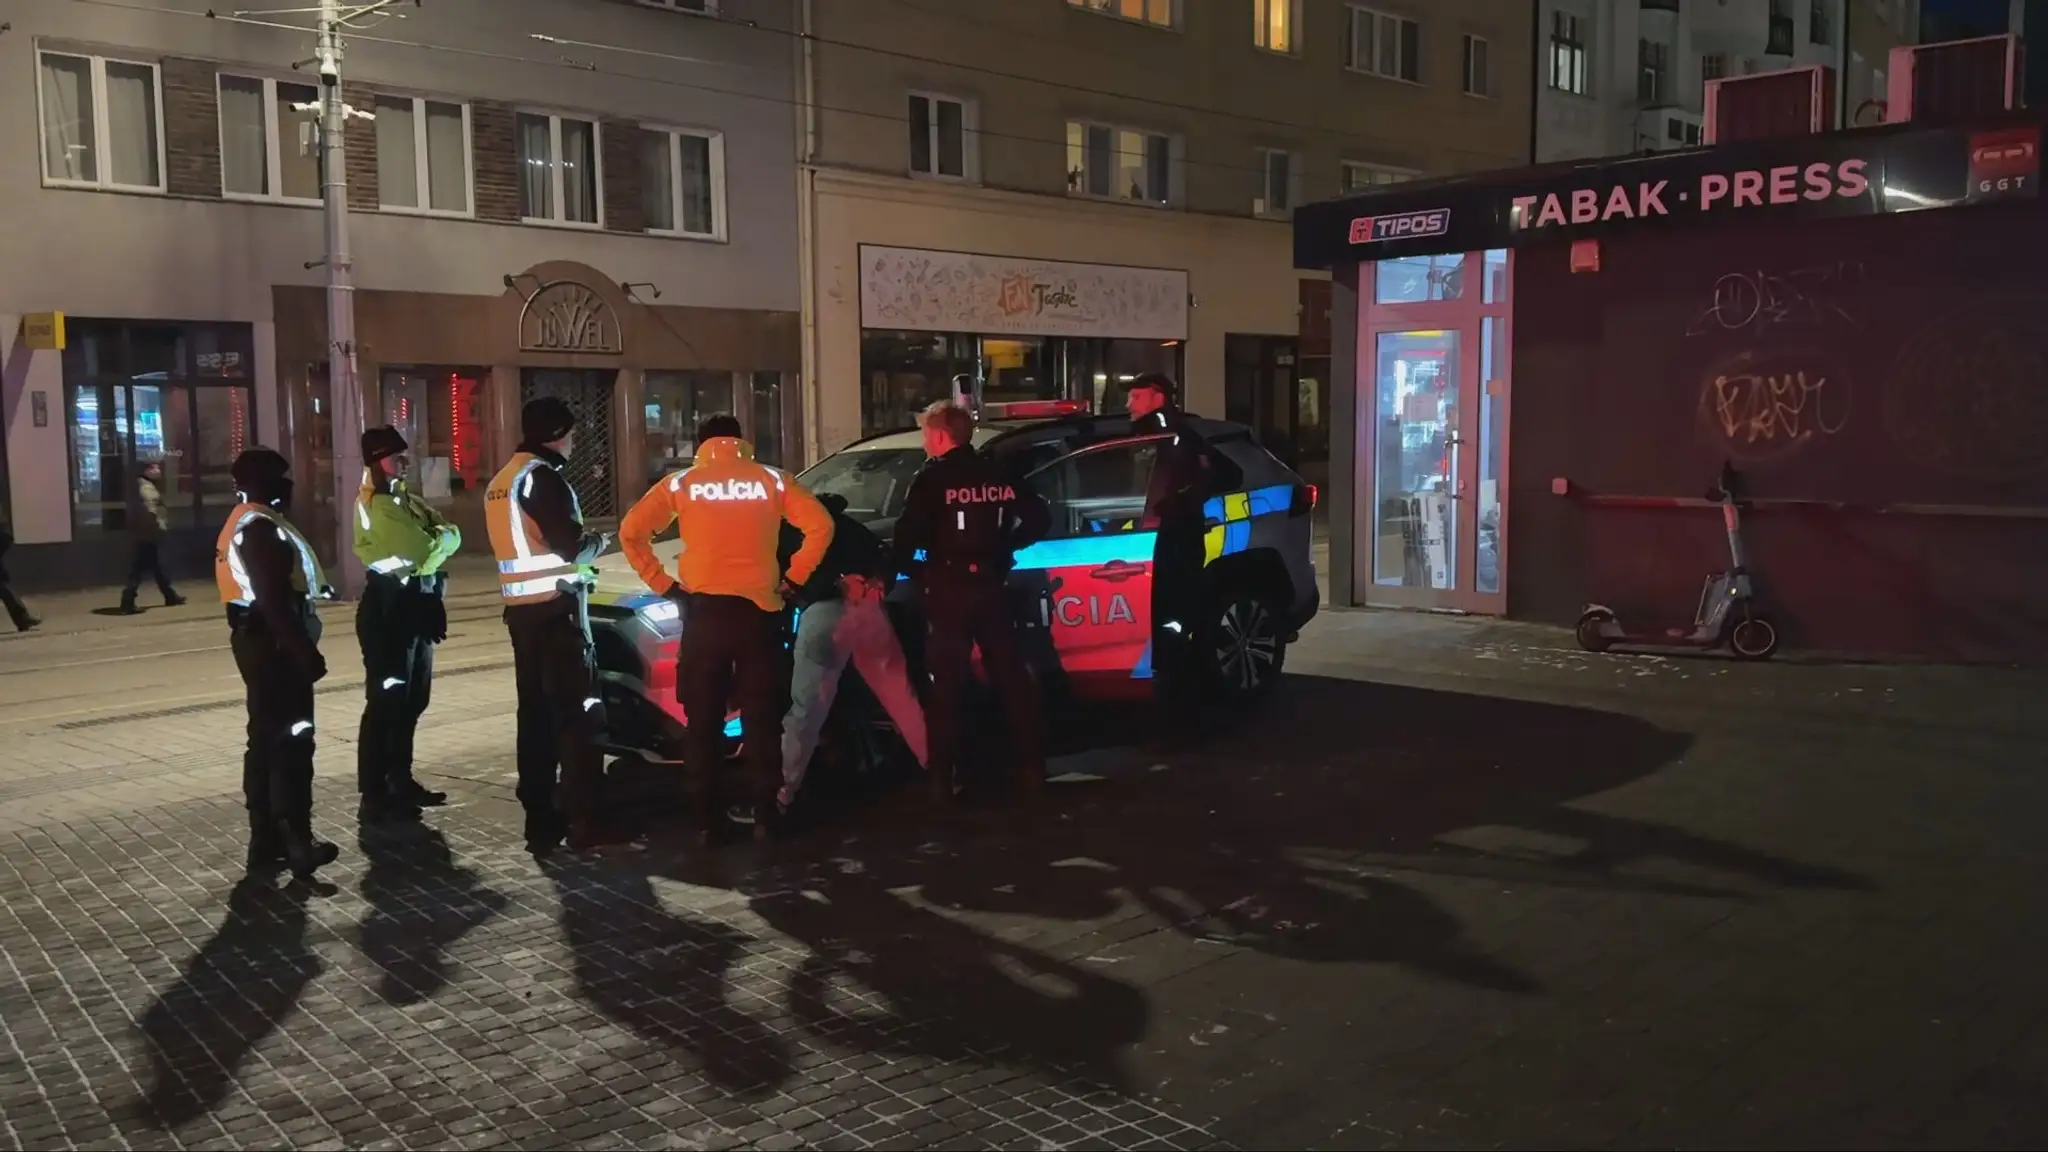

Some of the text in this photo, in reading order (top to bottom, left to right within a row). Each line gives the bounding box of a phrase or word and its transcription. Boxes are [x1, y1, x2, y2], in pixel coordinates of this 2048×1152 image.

[1512, 158, 1868, 230] TABAK PRESS
[1979, 175, 2026, 193] GGT
[1376, 213, 1443, 237] TIPOS
[689, 478, 769, 501] POLÍCIA
[945, 482, 1016, 504] POLÍCIA
[1014, 588, 1136, 628] ÍCIA
